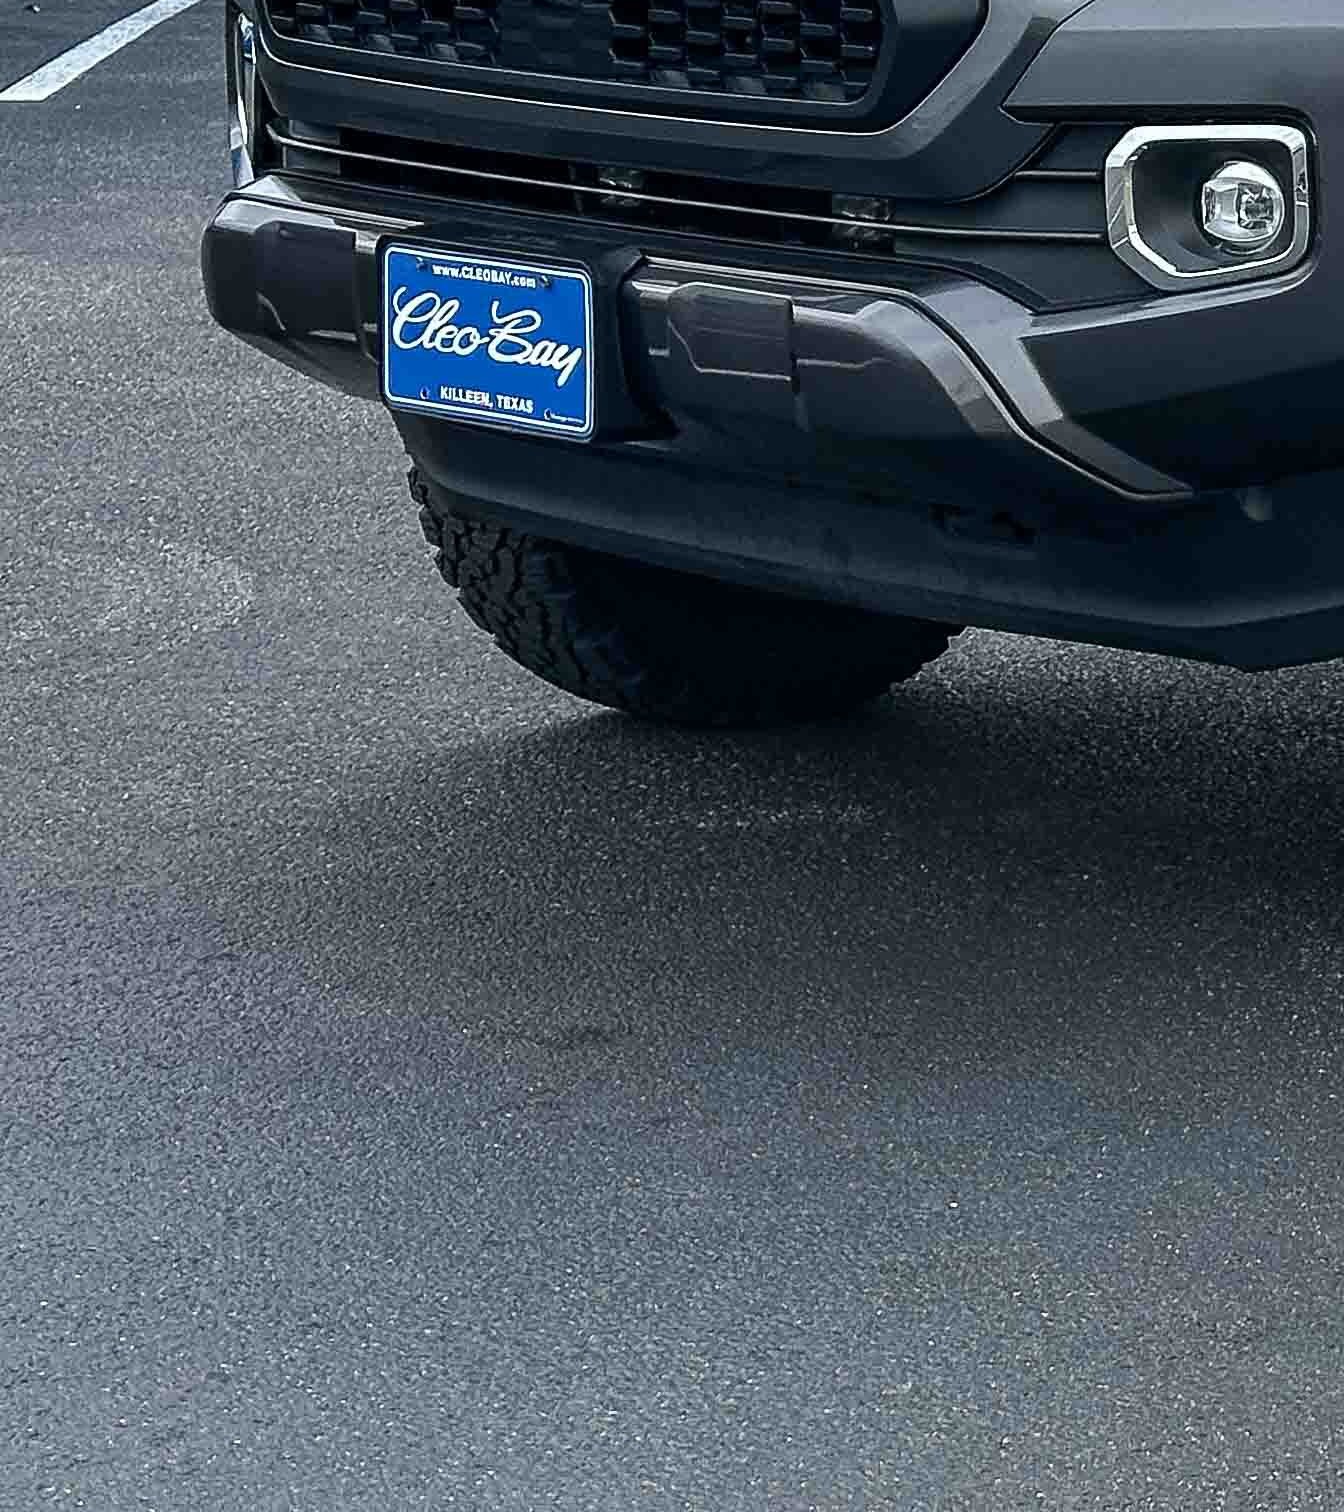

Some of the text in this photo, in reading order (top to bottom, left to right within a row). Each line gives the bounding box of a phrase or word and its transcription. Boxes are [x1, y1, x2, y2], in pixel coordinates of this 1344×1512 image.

[432, 263, 536, 288] www.CLEOBAY.com
[392, 286, 583, 387] Cleo Bay
[440, 385, 534, 414] KILLEEN, TEXAS
